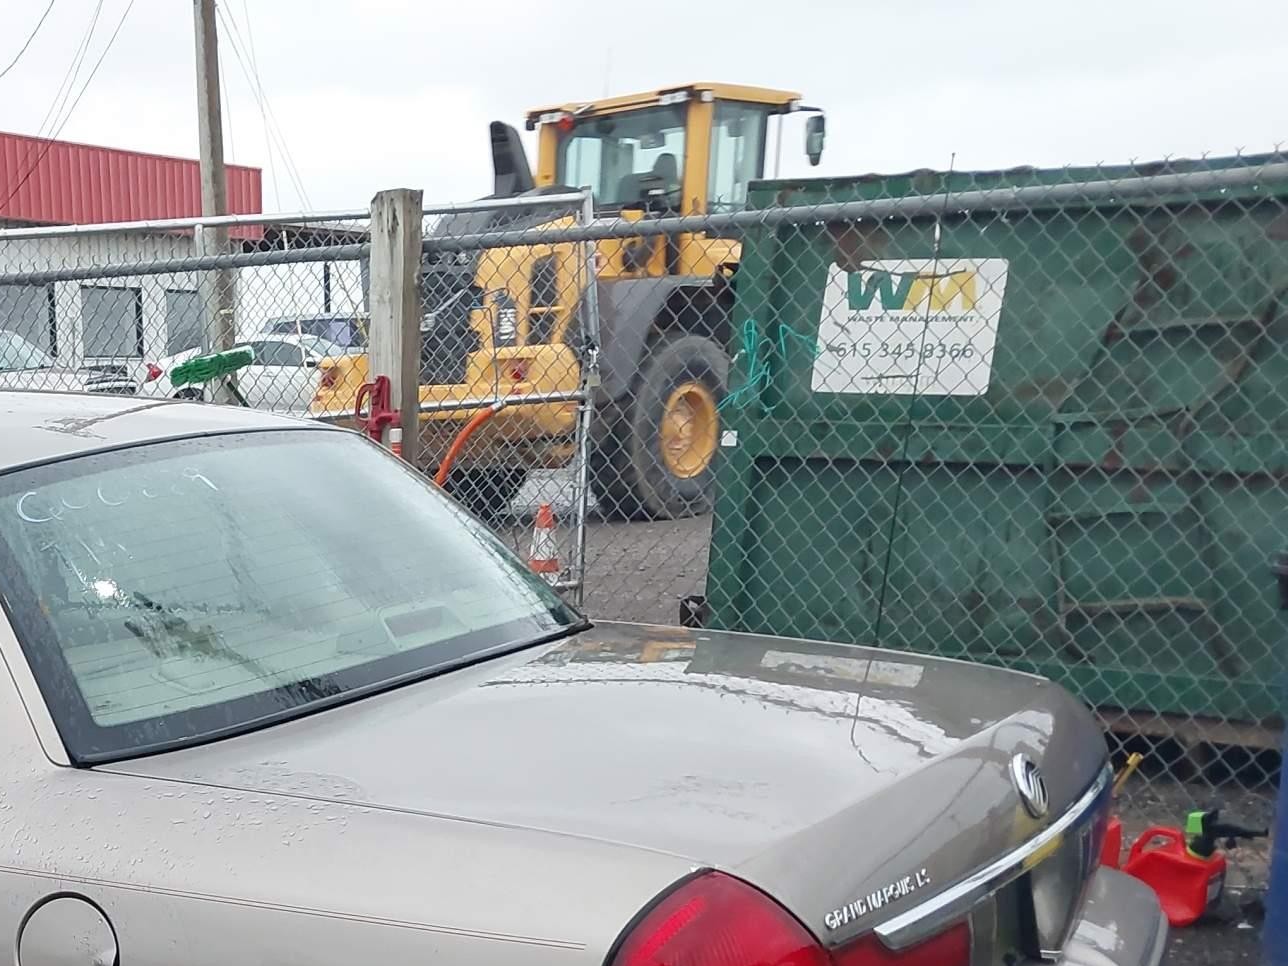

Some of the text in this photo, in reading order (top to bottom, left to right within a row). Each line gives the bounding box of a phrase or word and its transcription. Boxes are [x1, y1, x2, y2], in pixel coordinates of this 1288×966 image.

[847, 271, 977, 311] WM
[847, 315, 976, 323] WASTE MANAGEMENT
[836, 342, 974, 359] 615 345 8366
